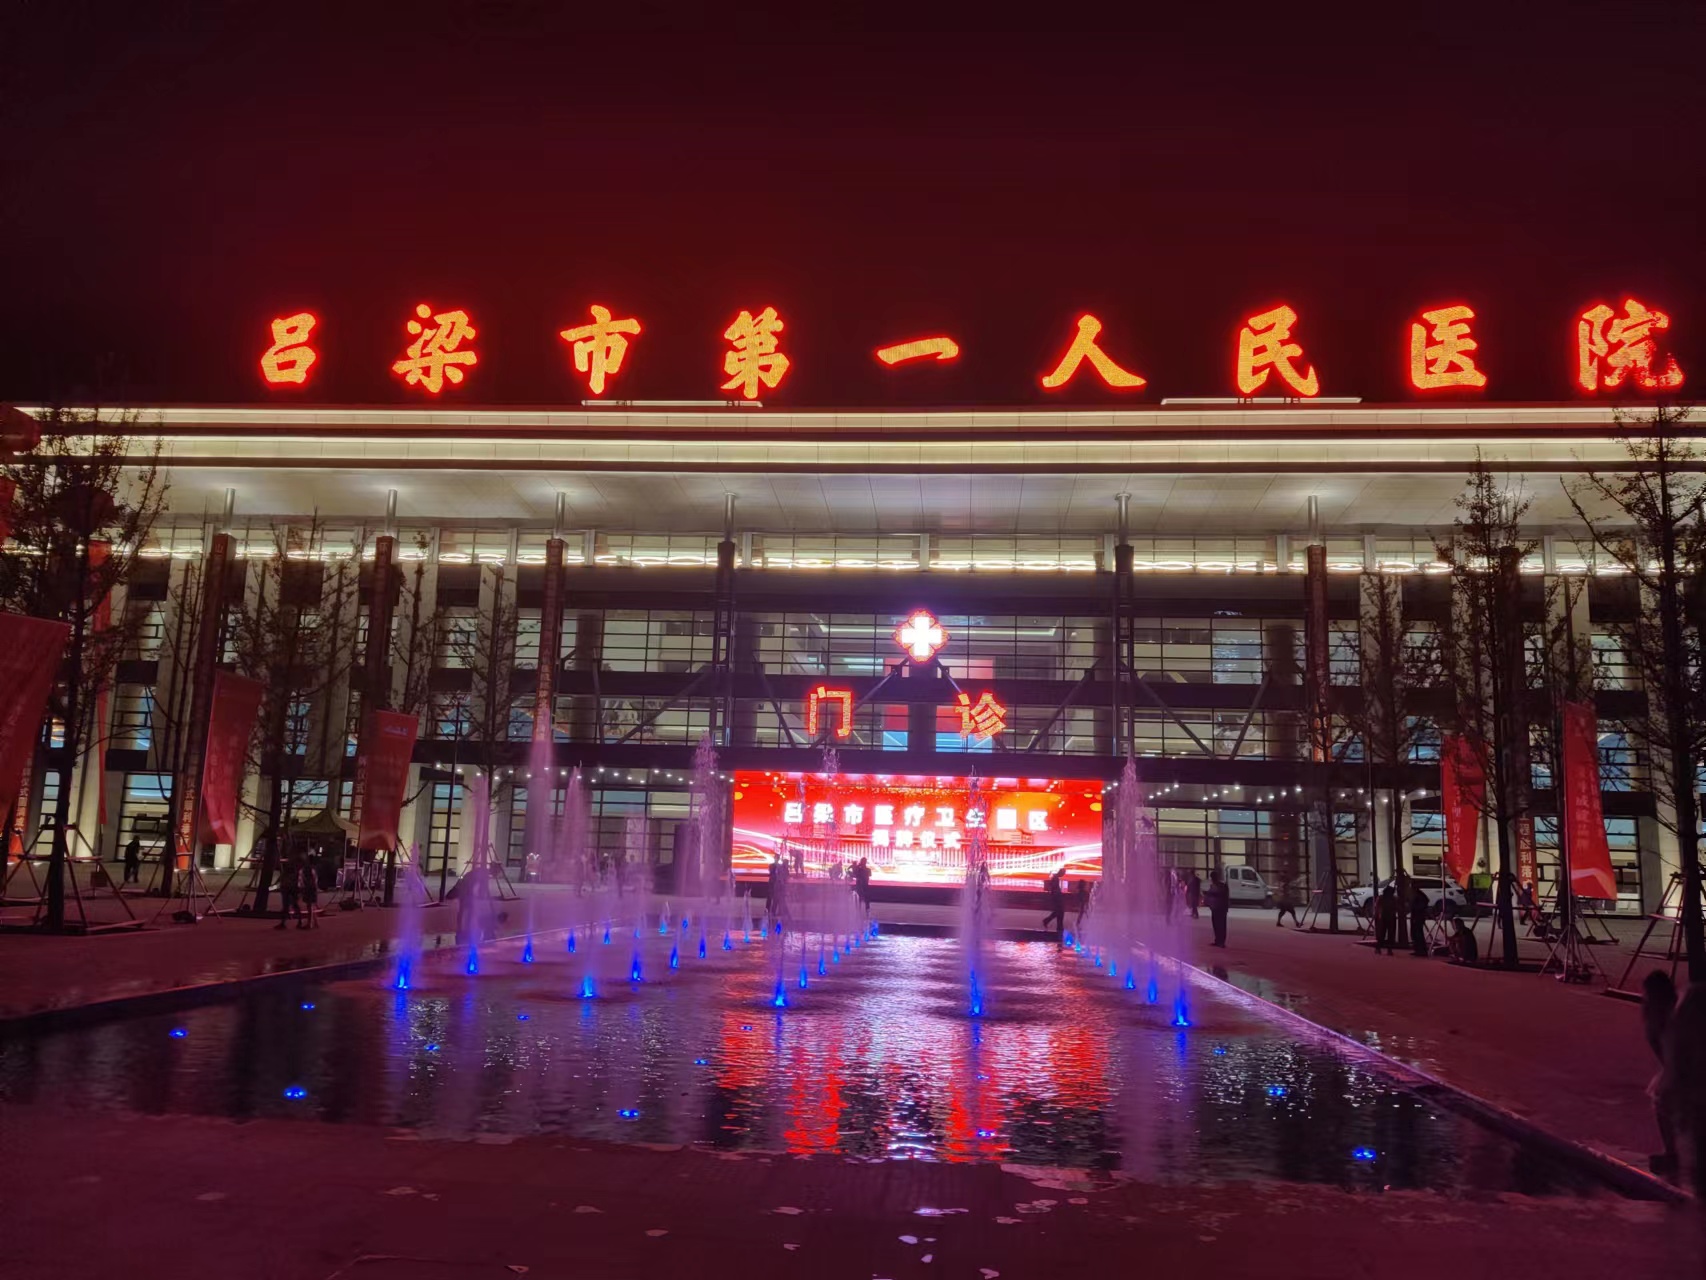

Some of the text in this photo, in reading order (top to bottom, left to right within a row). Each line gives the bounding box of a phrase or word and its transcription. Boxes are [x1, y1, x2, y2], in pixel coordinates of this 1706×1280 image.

[262, 301, 1683, 396] 吕梁市第一人民医院
[808, 686, 1006, 739] 门诊
